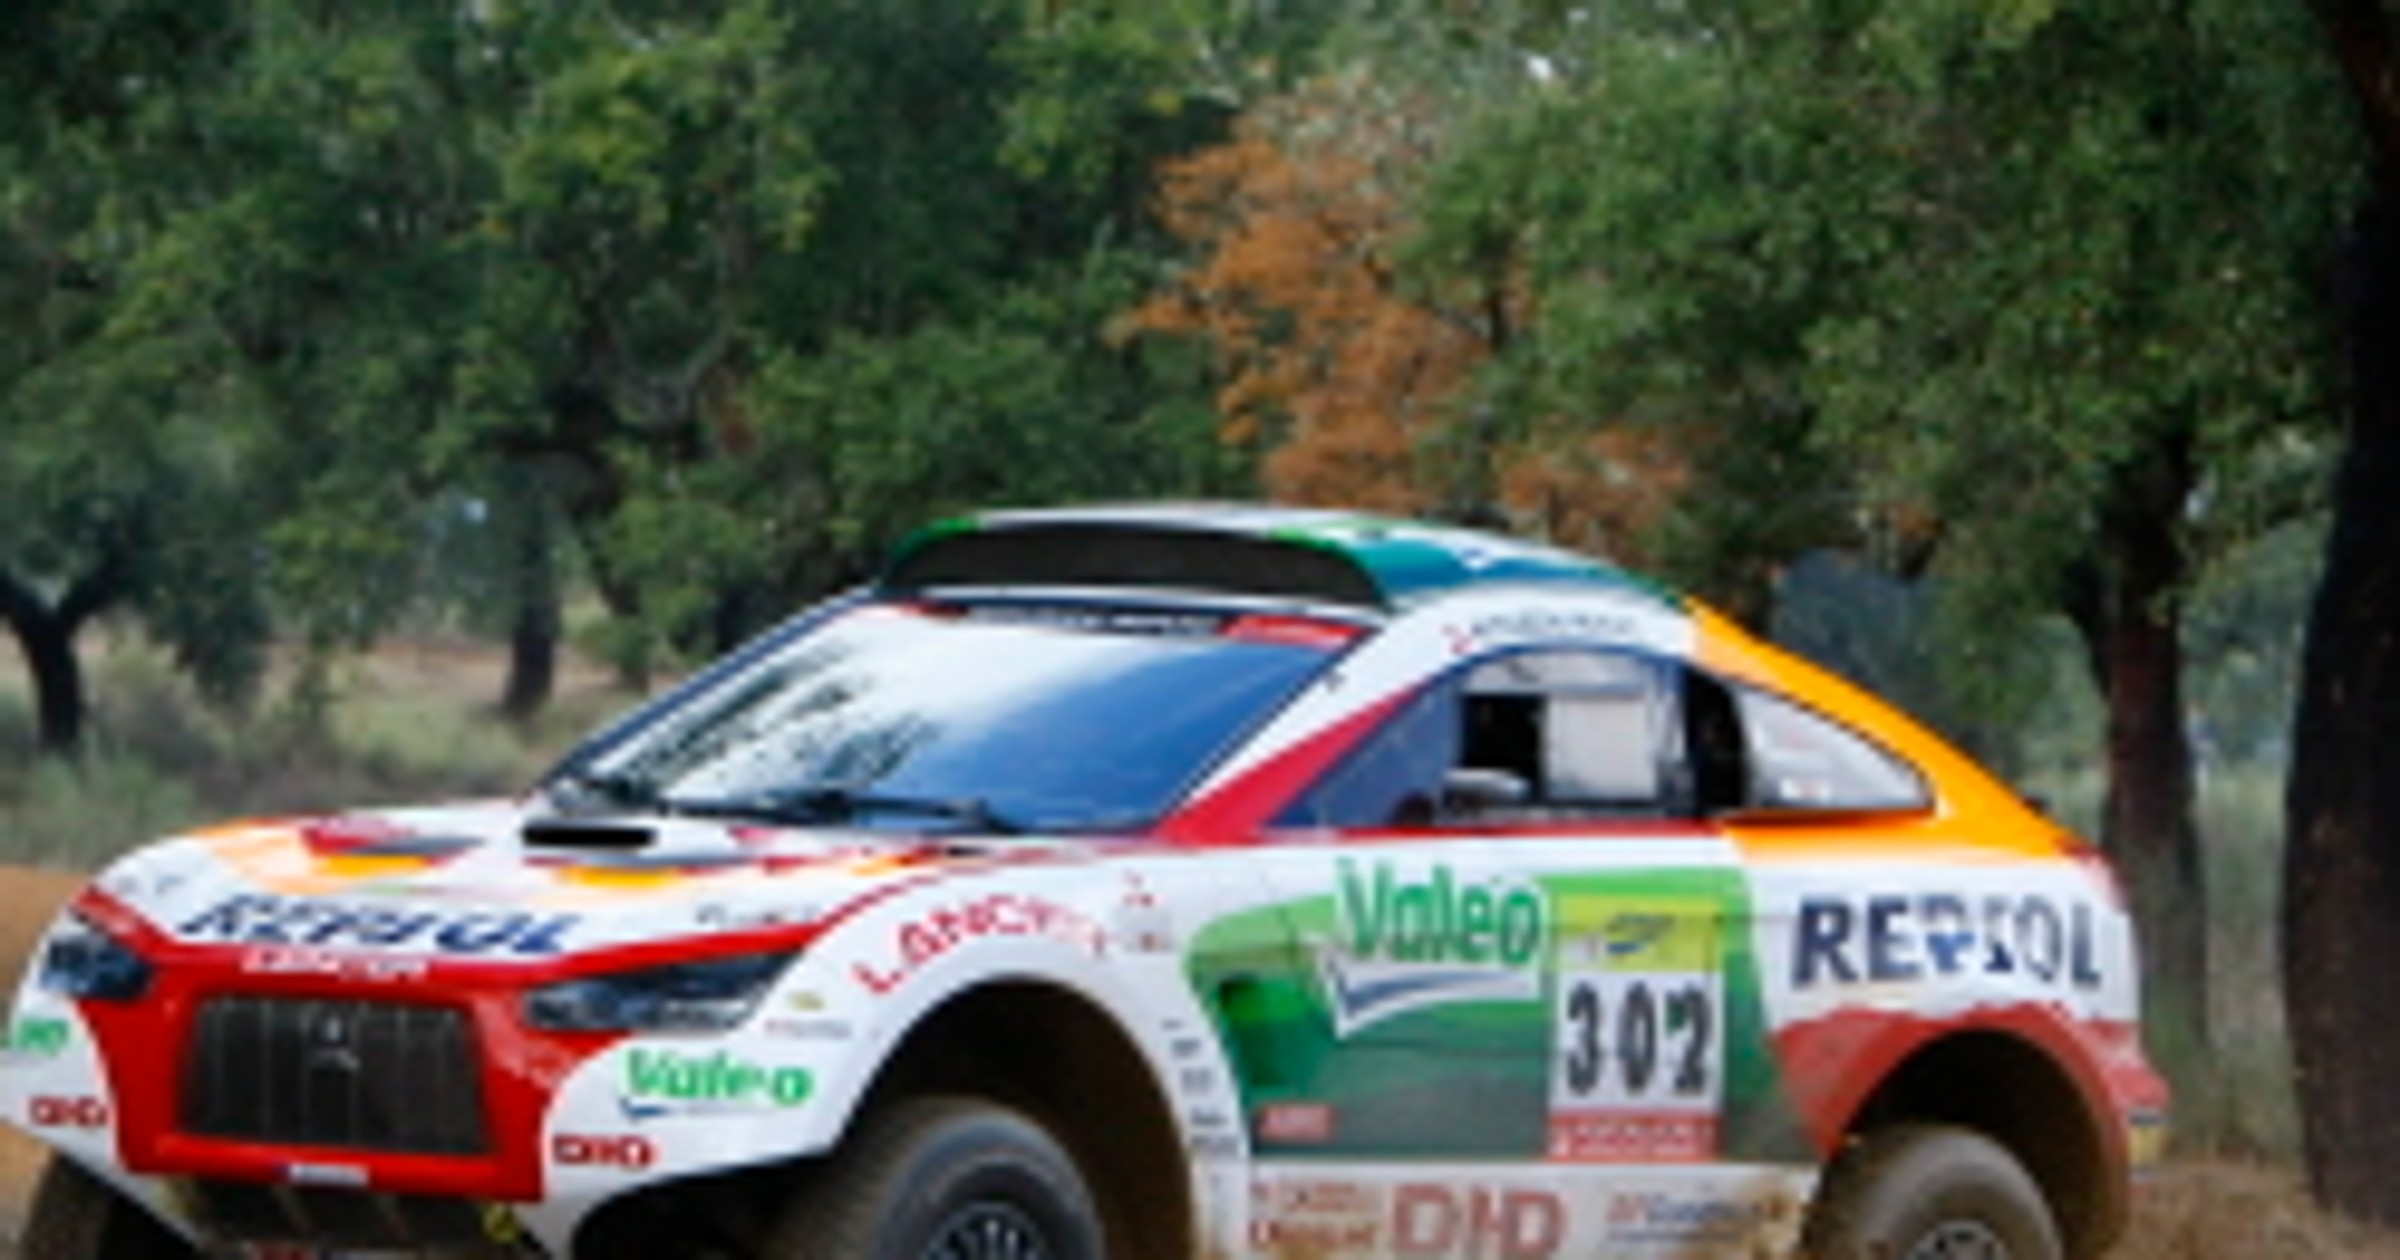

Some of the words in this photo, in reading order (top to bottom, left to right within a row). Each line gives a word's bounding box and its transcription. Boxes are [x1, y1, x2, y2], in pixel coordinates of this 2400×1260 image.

[848, 893, 1112, 995] LANC
[1335, 857, 1542, 966] Valeo
[1788, 893, 2104, 989] REPSOL
[628, 1046, 816, 1108] Valeo
[1564, 979, 1714, 1096] 302
